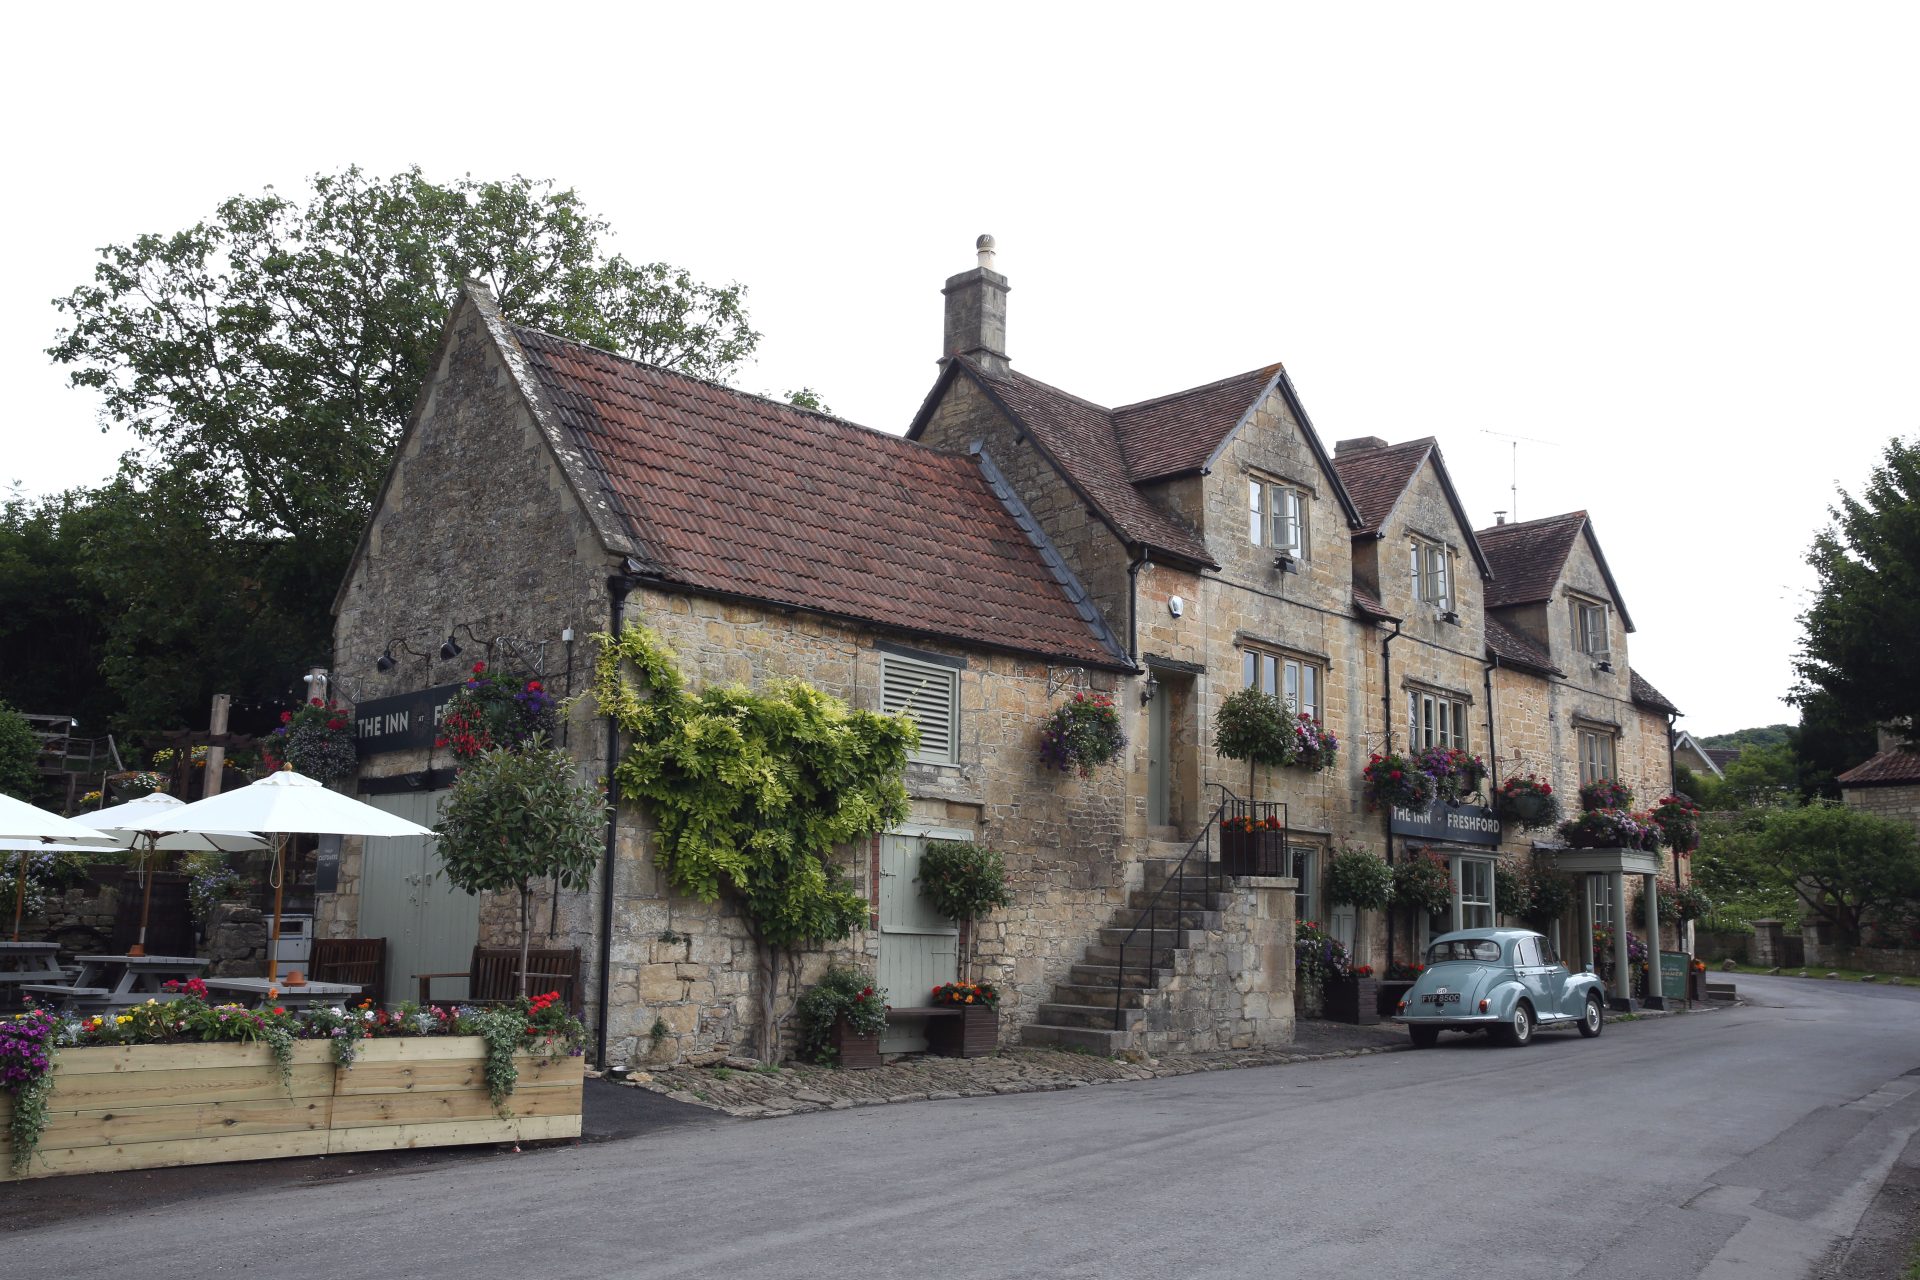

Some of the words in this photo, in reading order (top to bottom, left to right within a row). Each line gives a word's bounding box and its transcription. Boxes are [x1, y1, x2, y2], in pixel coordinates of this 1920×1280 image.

[358, 716, 381, 738] THE
[385, 710, 408, 734] INN
[1393, 805, 1411, 822] THE
[1447, 813, 1500, 833] FRESHFORD
